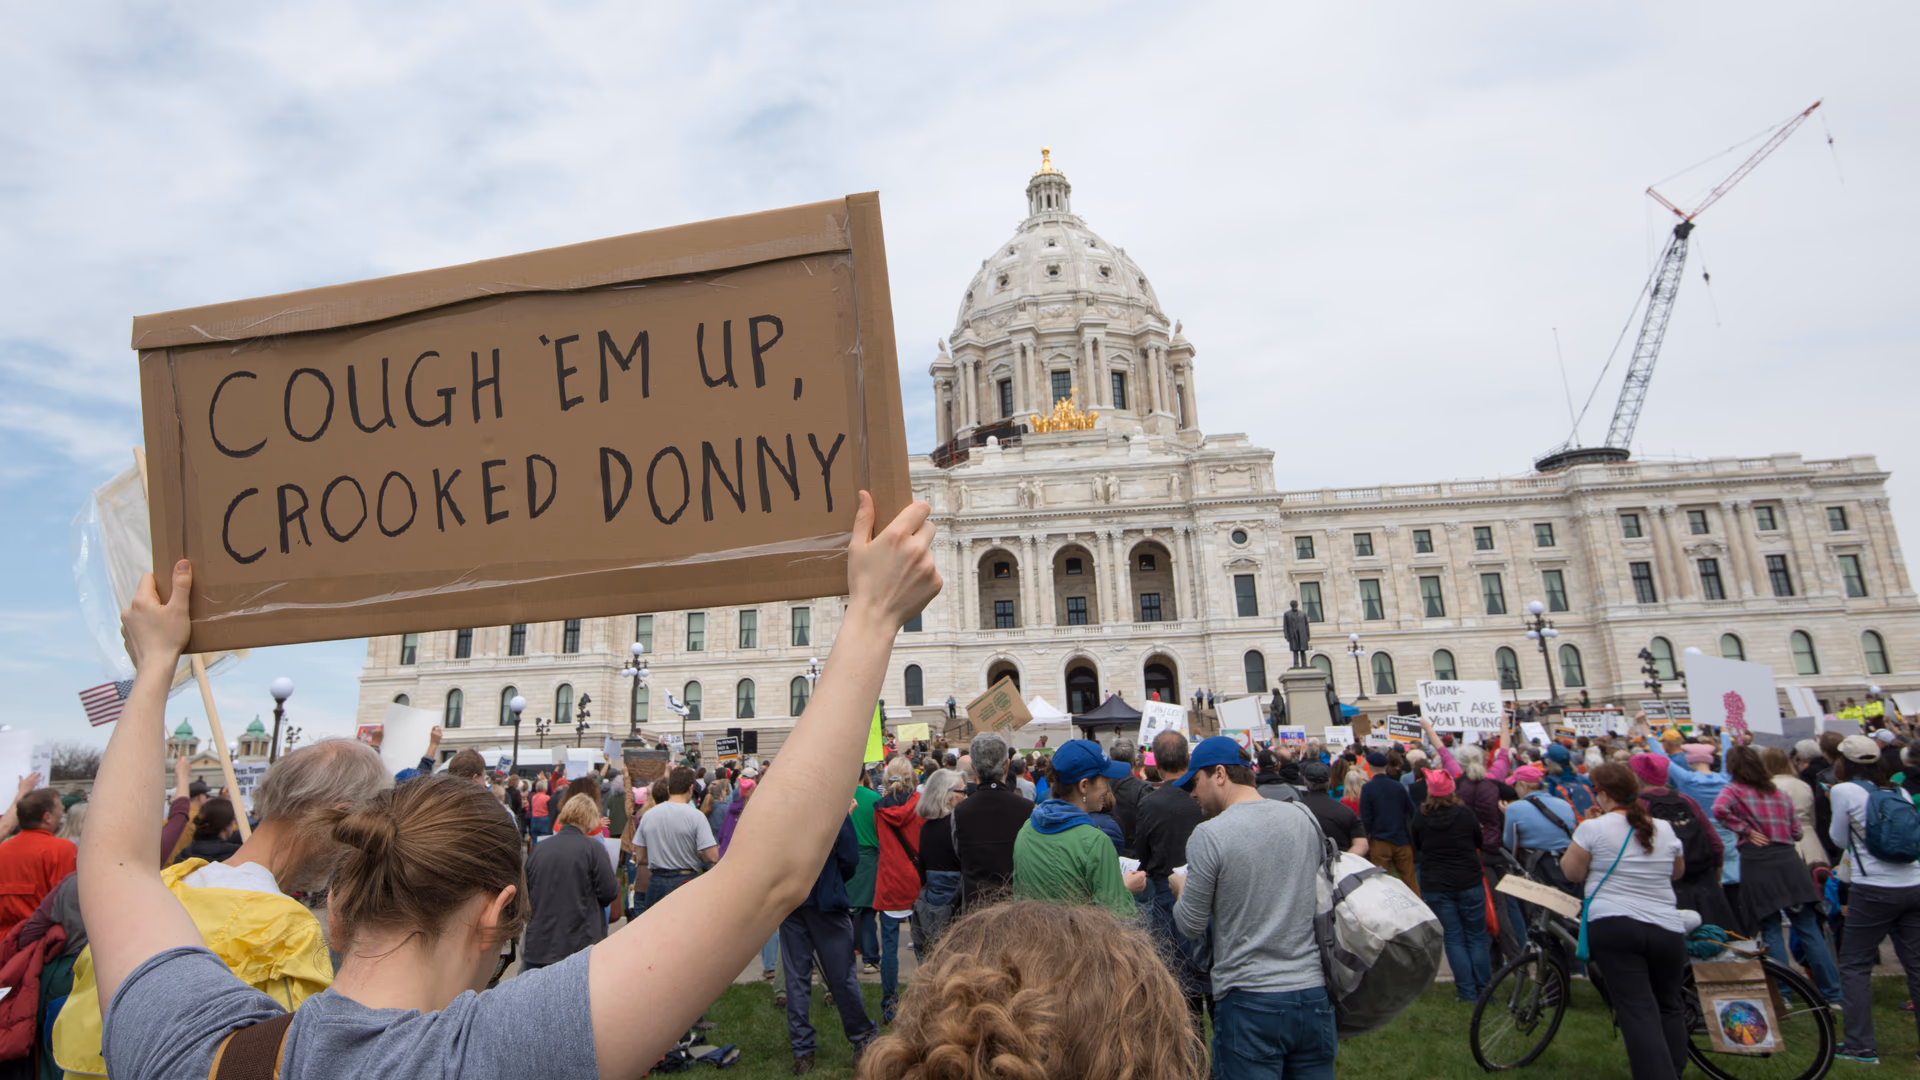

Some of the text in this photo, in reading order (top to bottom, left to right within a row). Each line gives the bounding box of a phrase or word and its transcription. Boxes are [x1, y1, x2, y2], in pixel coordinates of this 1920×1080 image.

[209, 314, 803, 458] COUGH 'EM UP,
[222, 433, 846, 564] CROOKED DONNY
[1425, 701, 1498, 713] WHAT ARE
[1428, 715, 1502, 728] YOU HIDING
